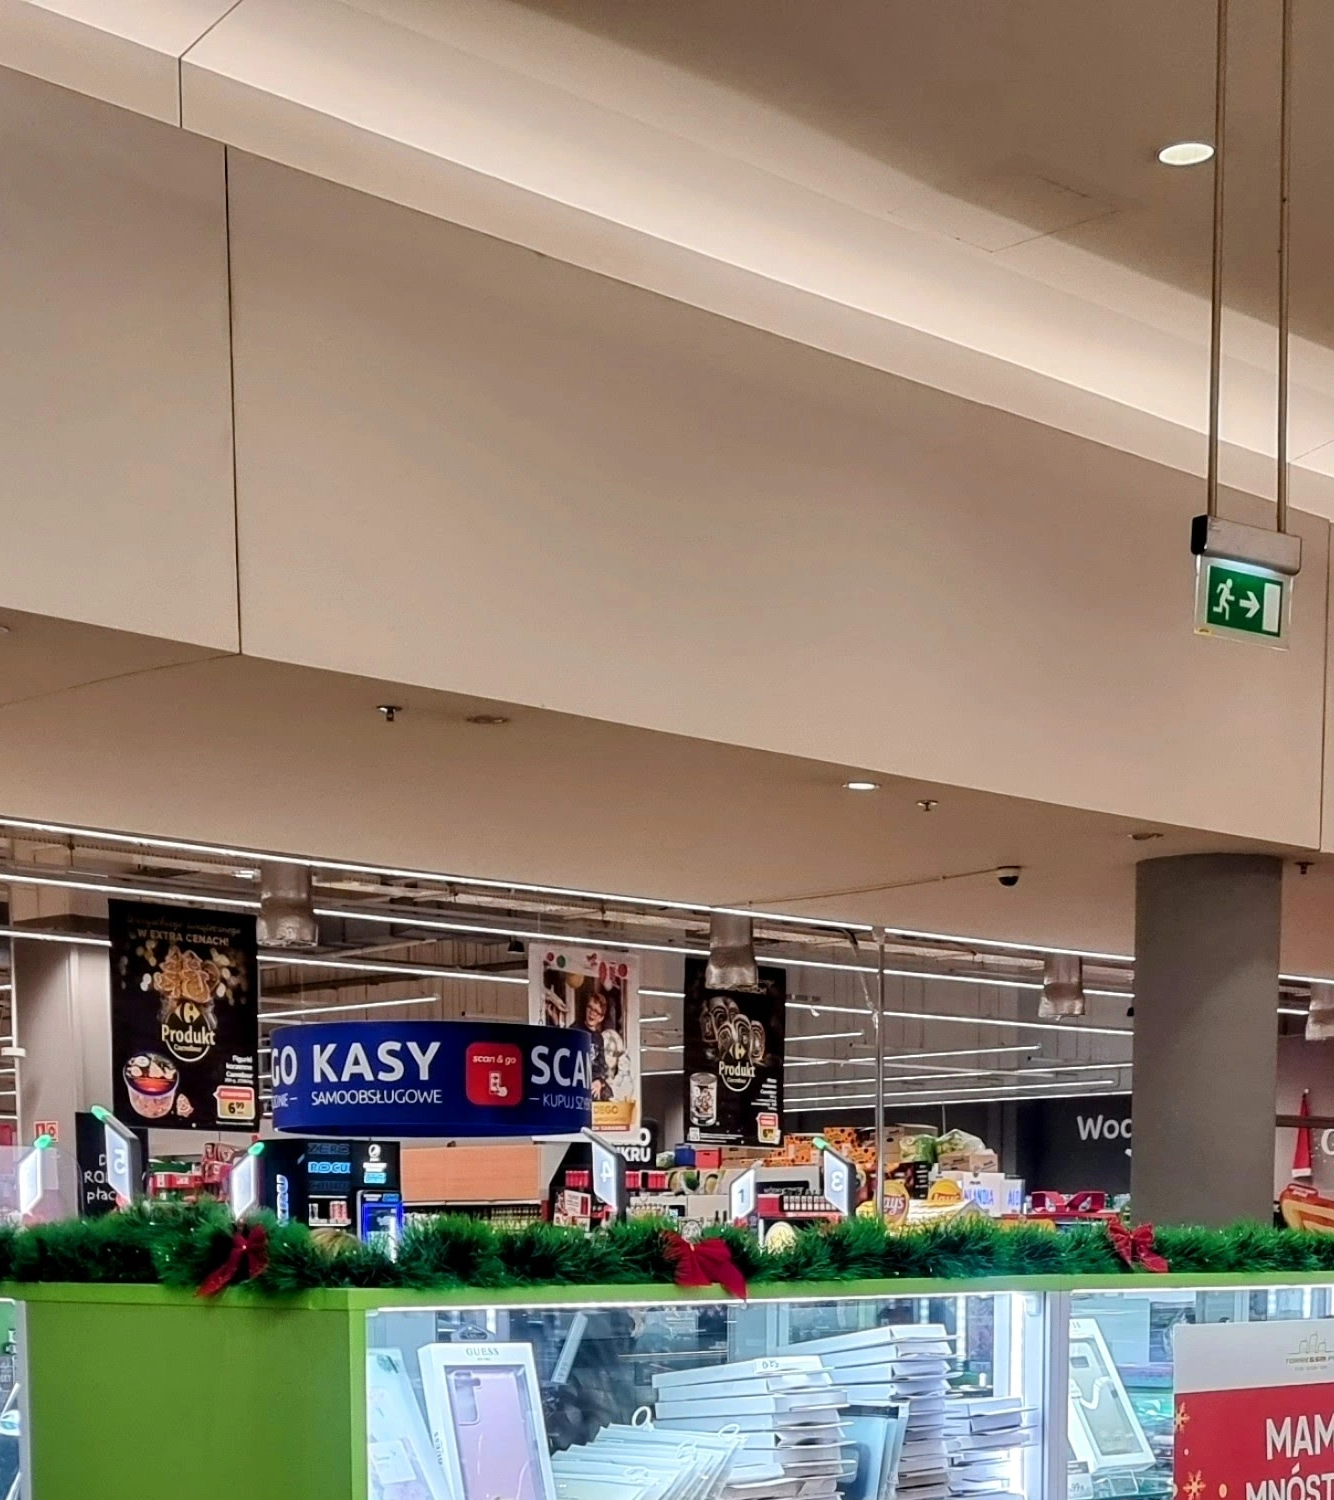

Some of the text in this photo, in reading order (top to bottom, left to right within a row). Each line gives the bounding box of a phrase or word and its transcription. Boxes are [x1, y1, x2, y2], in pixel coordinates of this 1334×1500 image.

[161, 1024, 216, 1046] Produkt
[312, 1041, 440, 1083] KASY
[472, 1055, 495, 1063] scan
[505, 1056, 516, 1066] go
[718, 1061, 756, 1079] Produkt
[312, 1089, 443, 1107] SAMOOBSŁUGOWE
[884, 1196, 905, 1215] ays
[465, 1347, 500, 1357] GUESS
